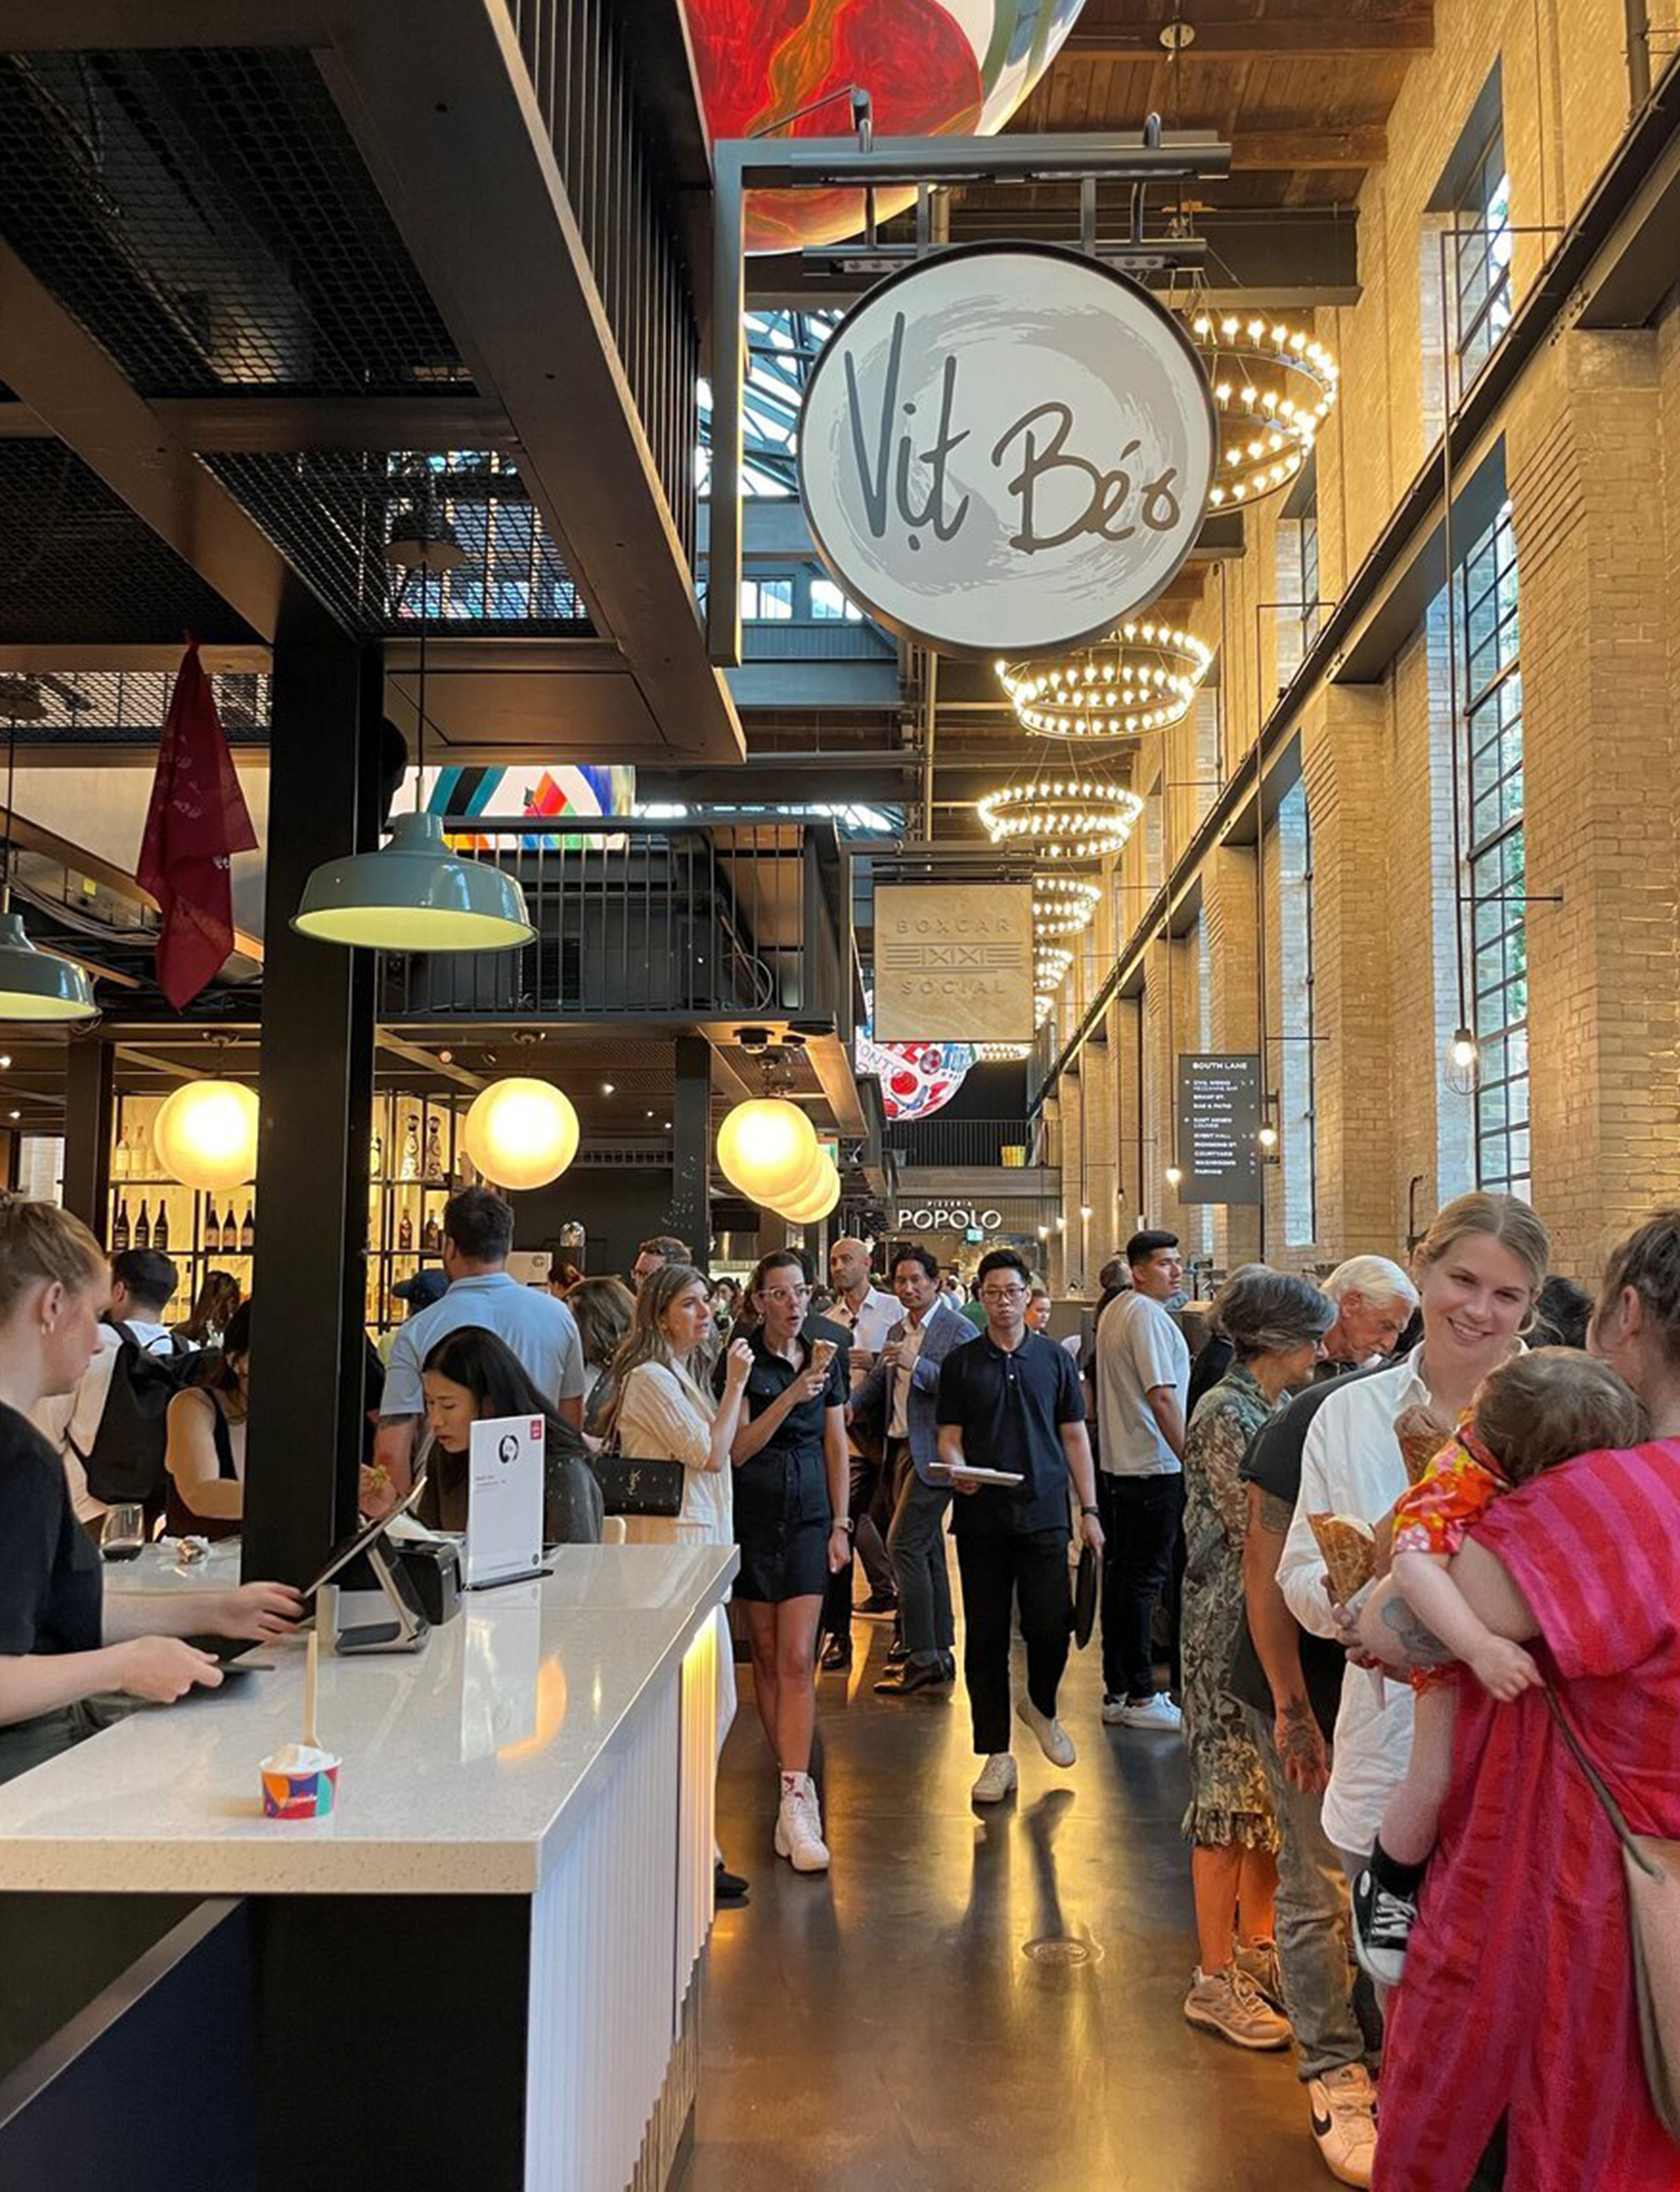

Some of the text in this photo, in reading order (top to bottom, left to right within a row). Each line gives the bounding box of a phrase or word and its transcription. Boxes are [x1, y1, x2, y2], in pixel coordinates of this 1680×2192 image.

[991, 401, 1181, 555] Béo
[896, 917, 1011, 934] BOXCAR
[901, 981, 1006, 996] SOCIAL
[898, 1209, 1002, 1229] POPOLO
